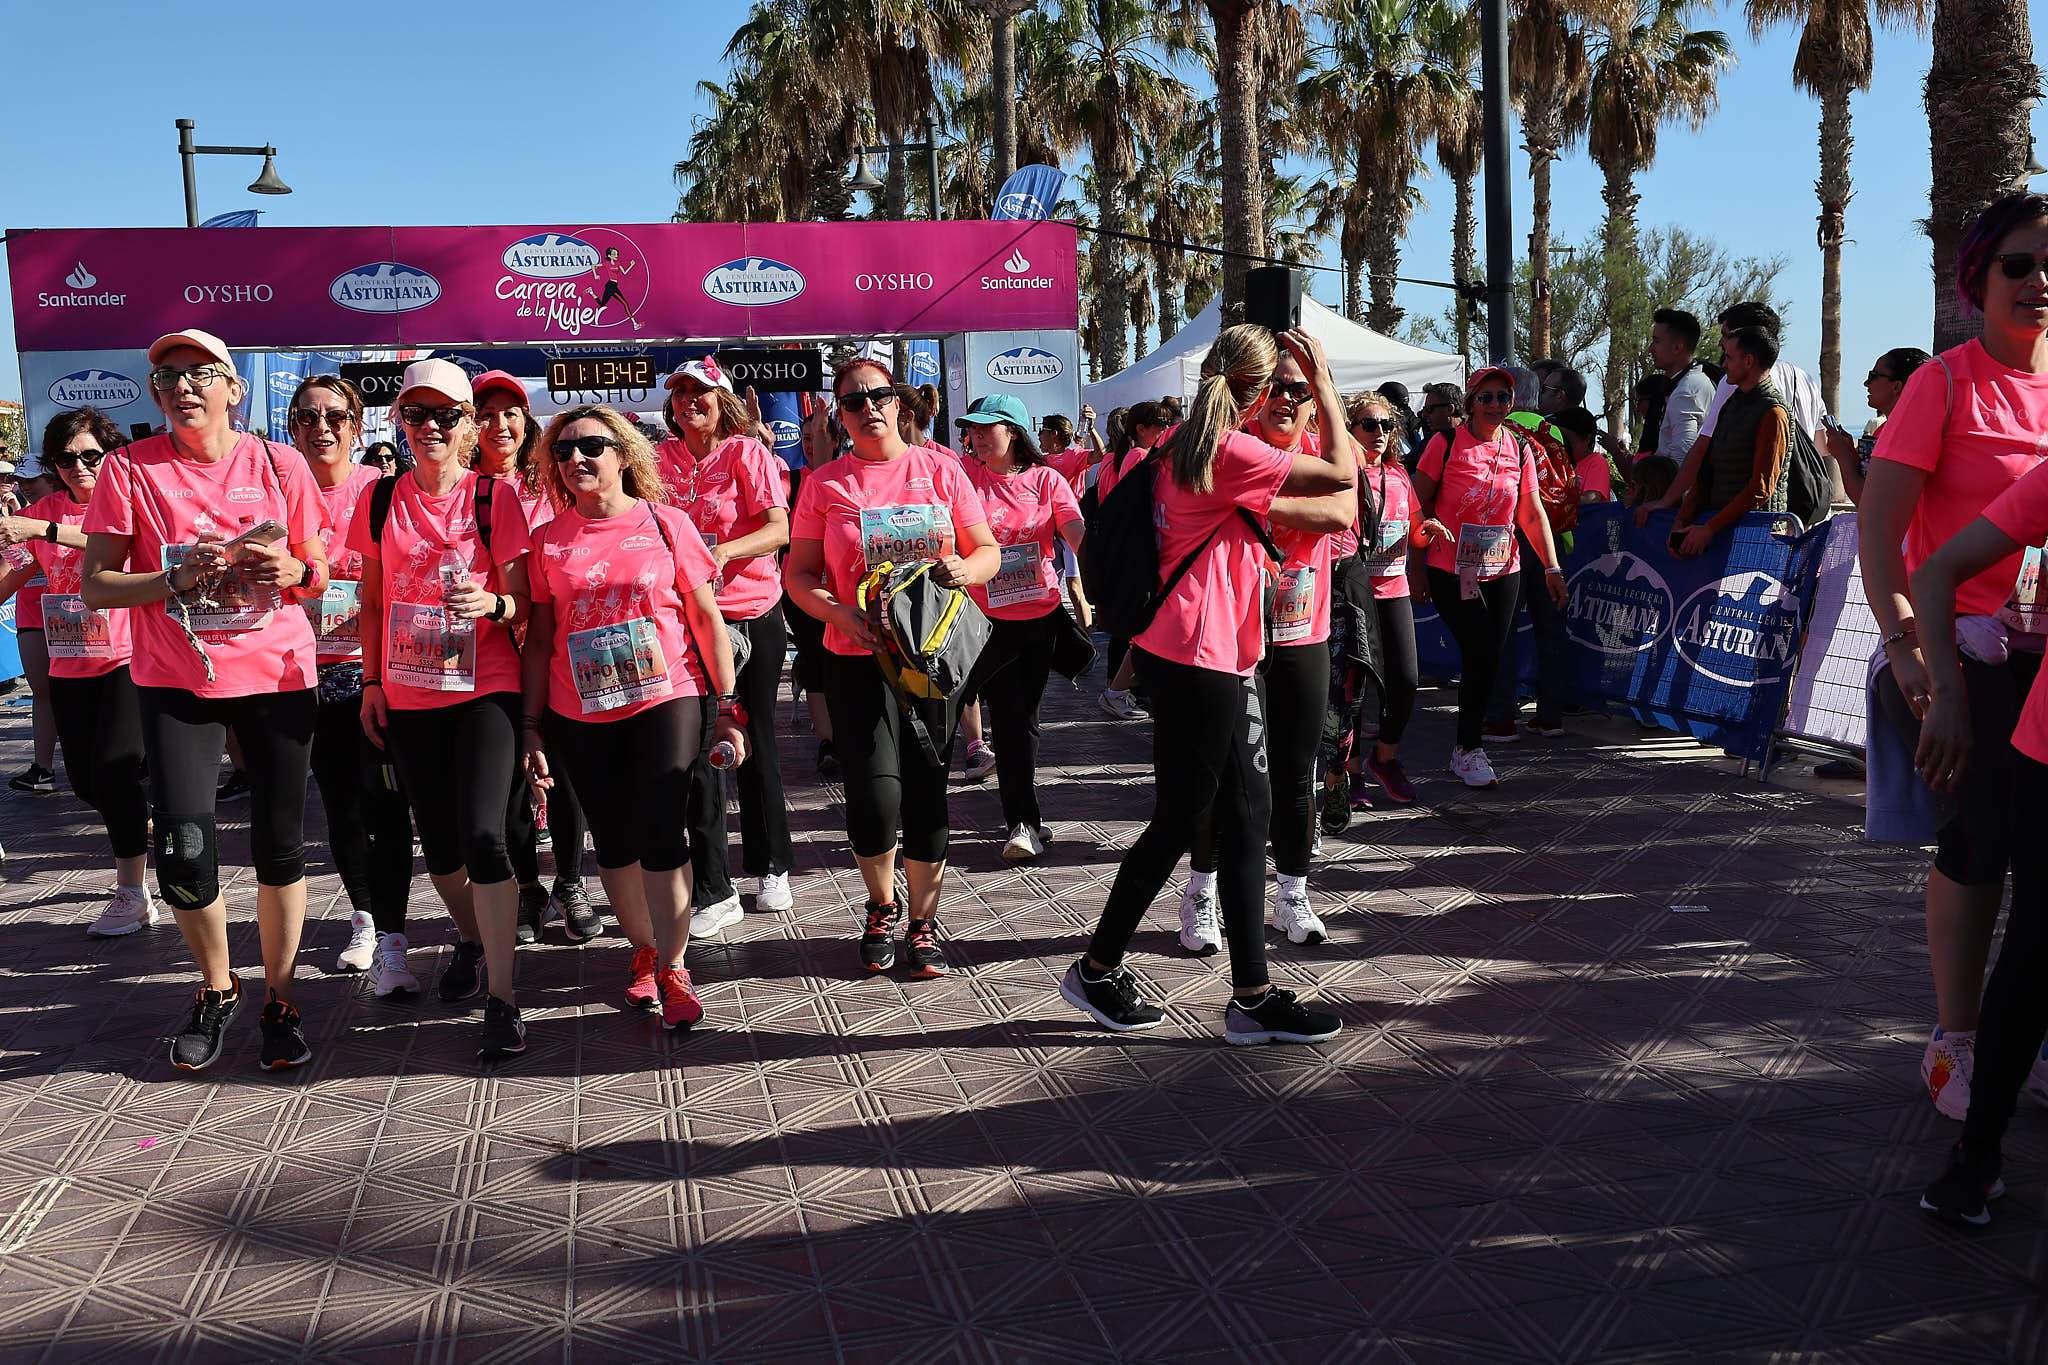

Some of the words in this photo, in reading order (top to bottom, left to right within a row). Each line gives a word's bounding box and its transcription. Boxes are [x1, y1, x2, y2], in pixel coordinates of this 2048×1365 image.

[511, 250, 593, 267] ASTURIANA
[495, 275, 577, 300] Carrera
[711, 275, 798, 294] ASTURIANA
[855, 272, 934, 291] OYSHO
[981, 275, 1054, 290] Santander
[38, 292, 127, 308] Santander
[184, 284, 274, 304] OYSHO
[338, 281, 433, 301] ASTURIANA
[516, 300, 532, 317] de
[535, 300, 546, 317] la
[545, 297, 608, 336] Mujer
[732, 362, 808, 380] OYSHO
[993, 361, 1058, 376] ASTURIANA
[56, 385, 134, 401] ASTURIANA
[361, 375, 403, 393] OYS
[551, 388, 648, 405] OYSHO
[890, 516, 924, 525] ASTURIANA
[893, 538, 926, 552] 016
[601, 658, 636, 677] 016
